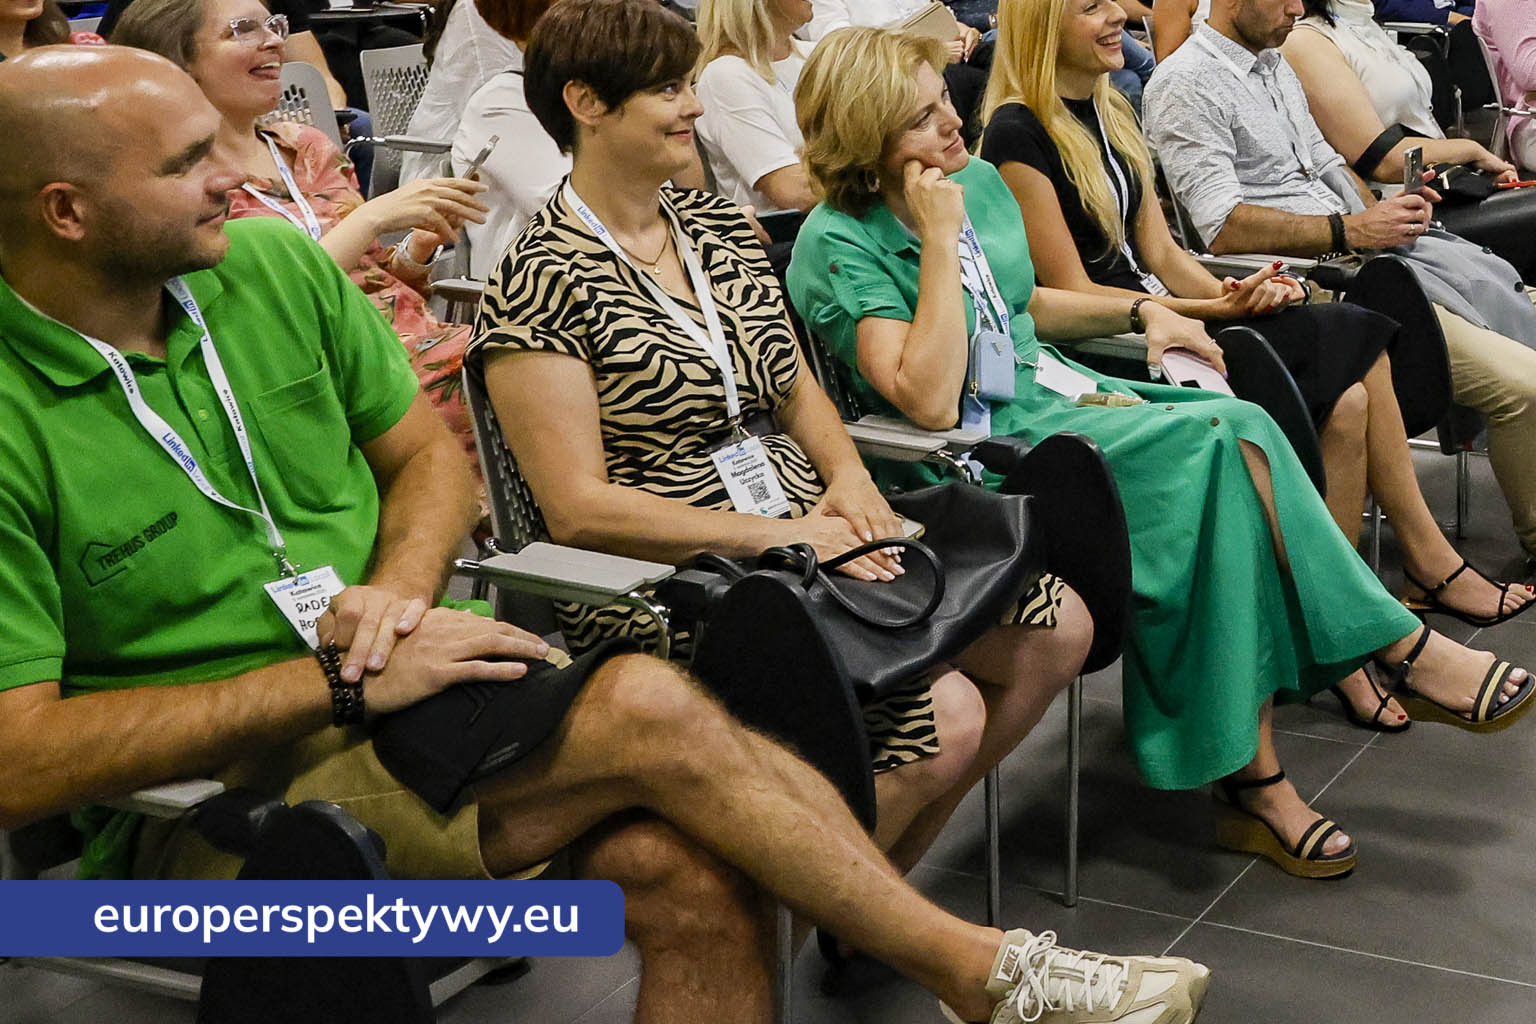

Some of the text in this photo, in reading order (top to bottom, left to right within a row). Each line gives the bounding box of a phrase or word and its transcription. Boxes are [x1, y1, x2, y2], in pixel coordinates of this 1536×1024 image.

[107, 351, 135, 395] Katowice
[223, 388, 243, 432] Katowice
[162, 432, 196, 473] LinkedIn
